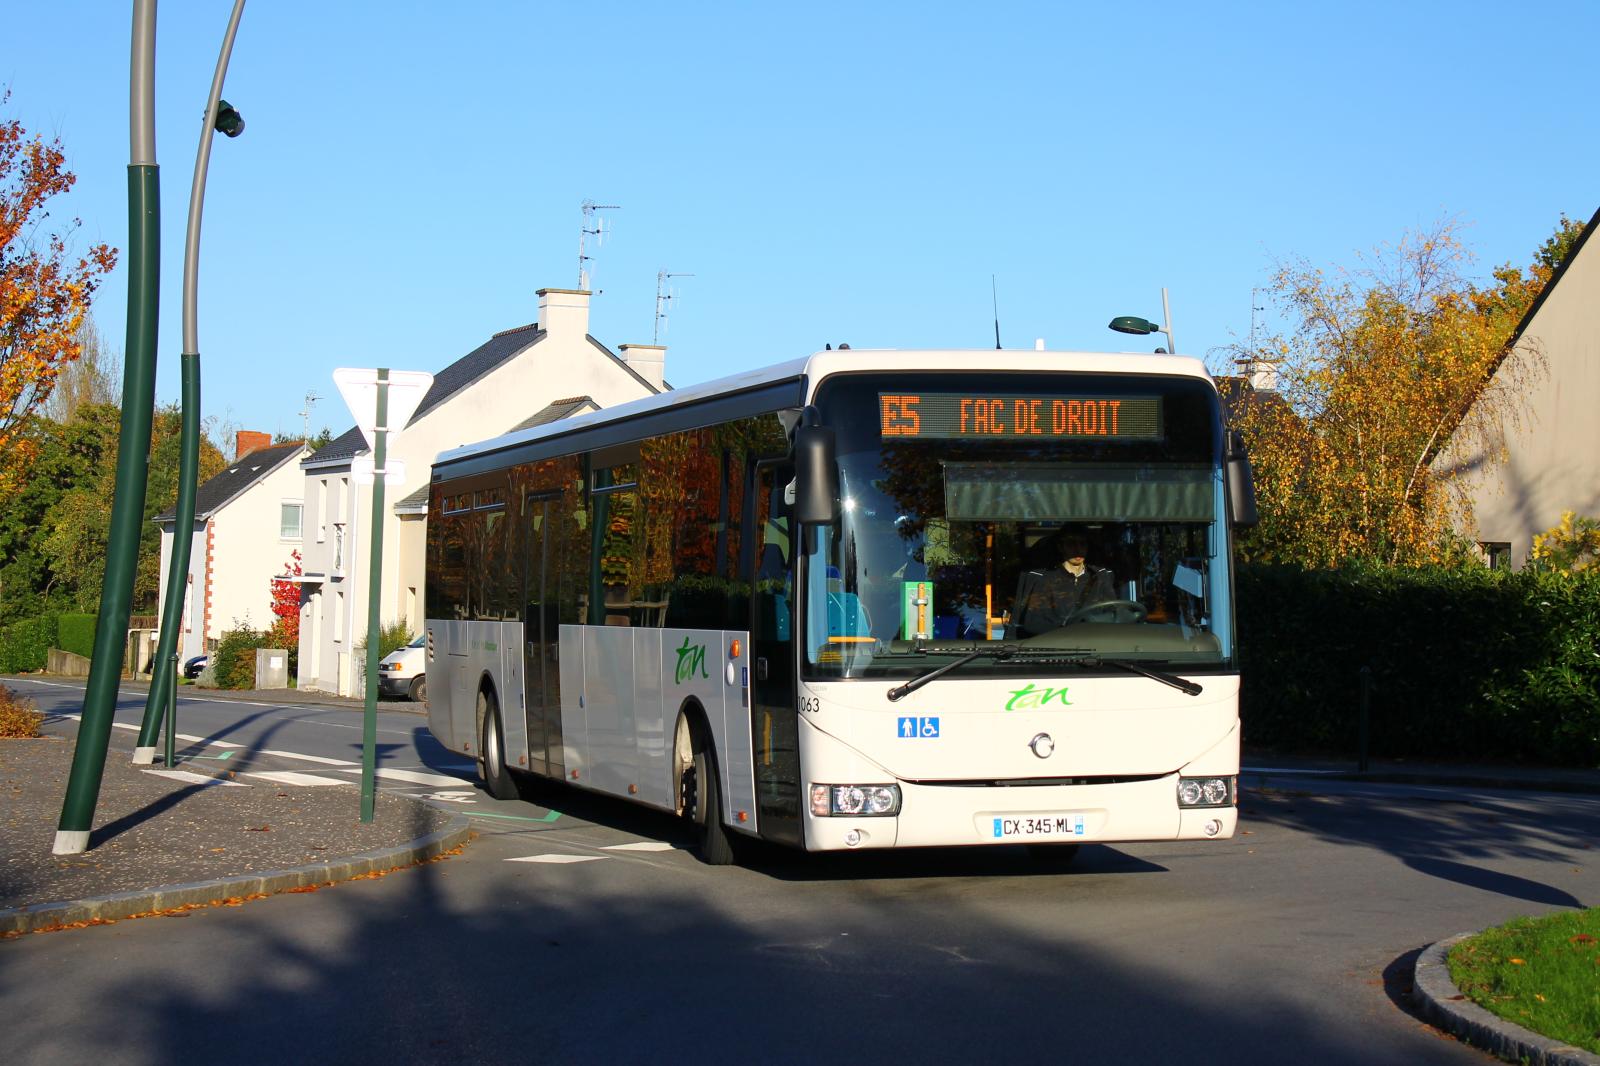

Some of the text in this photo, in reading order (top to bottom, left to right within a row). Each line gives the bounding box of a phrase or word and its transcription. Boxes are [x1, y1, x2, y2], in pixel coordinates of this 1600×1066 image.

[881, 395, 1121, 435] E5 FAC DE DROIT
[675, 636, 709, 685] tan
[1005, 683, 1074, 711] tan
